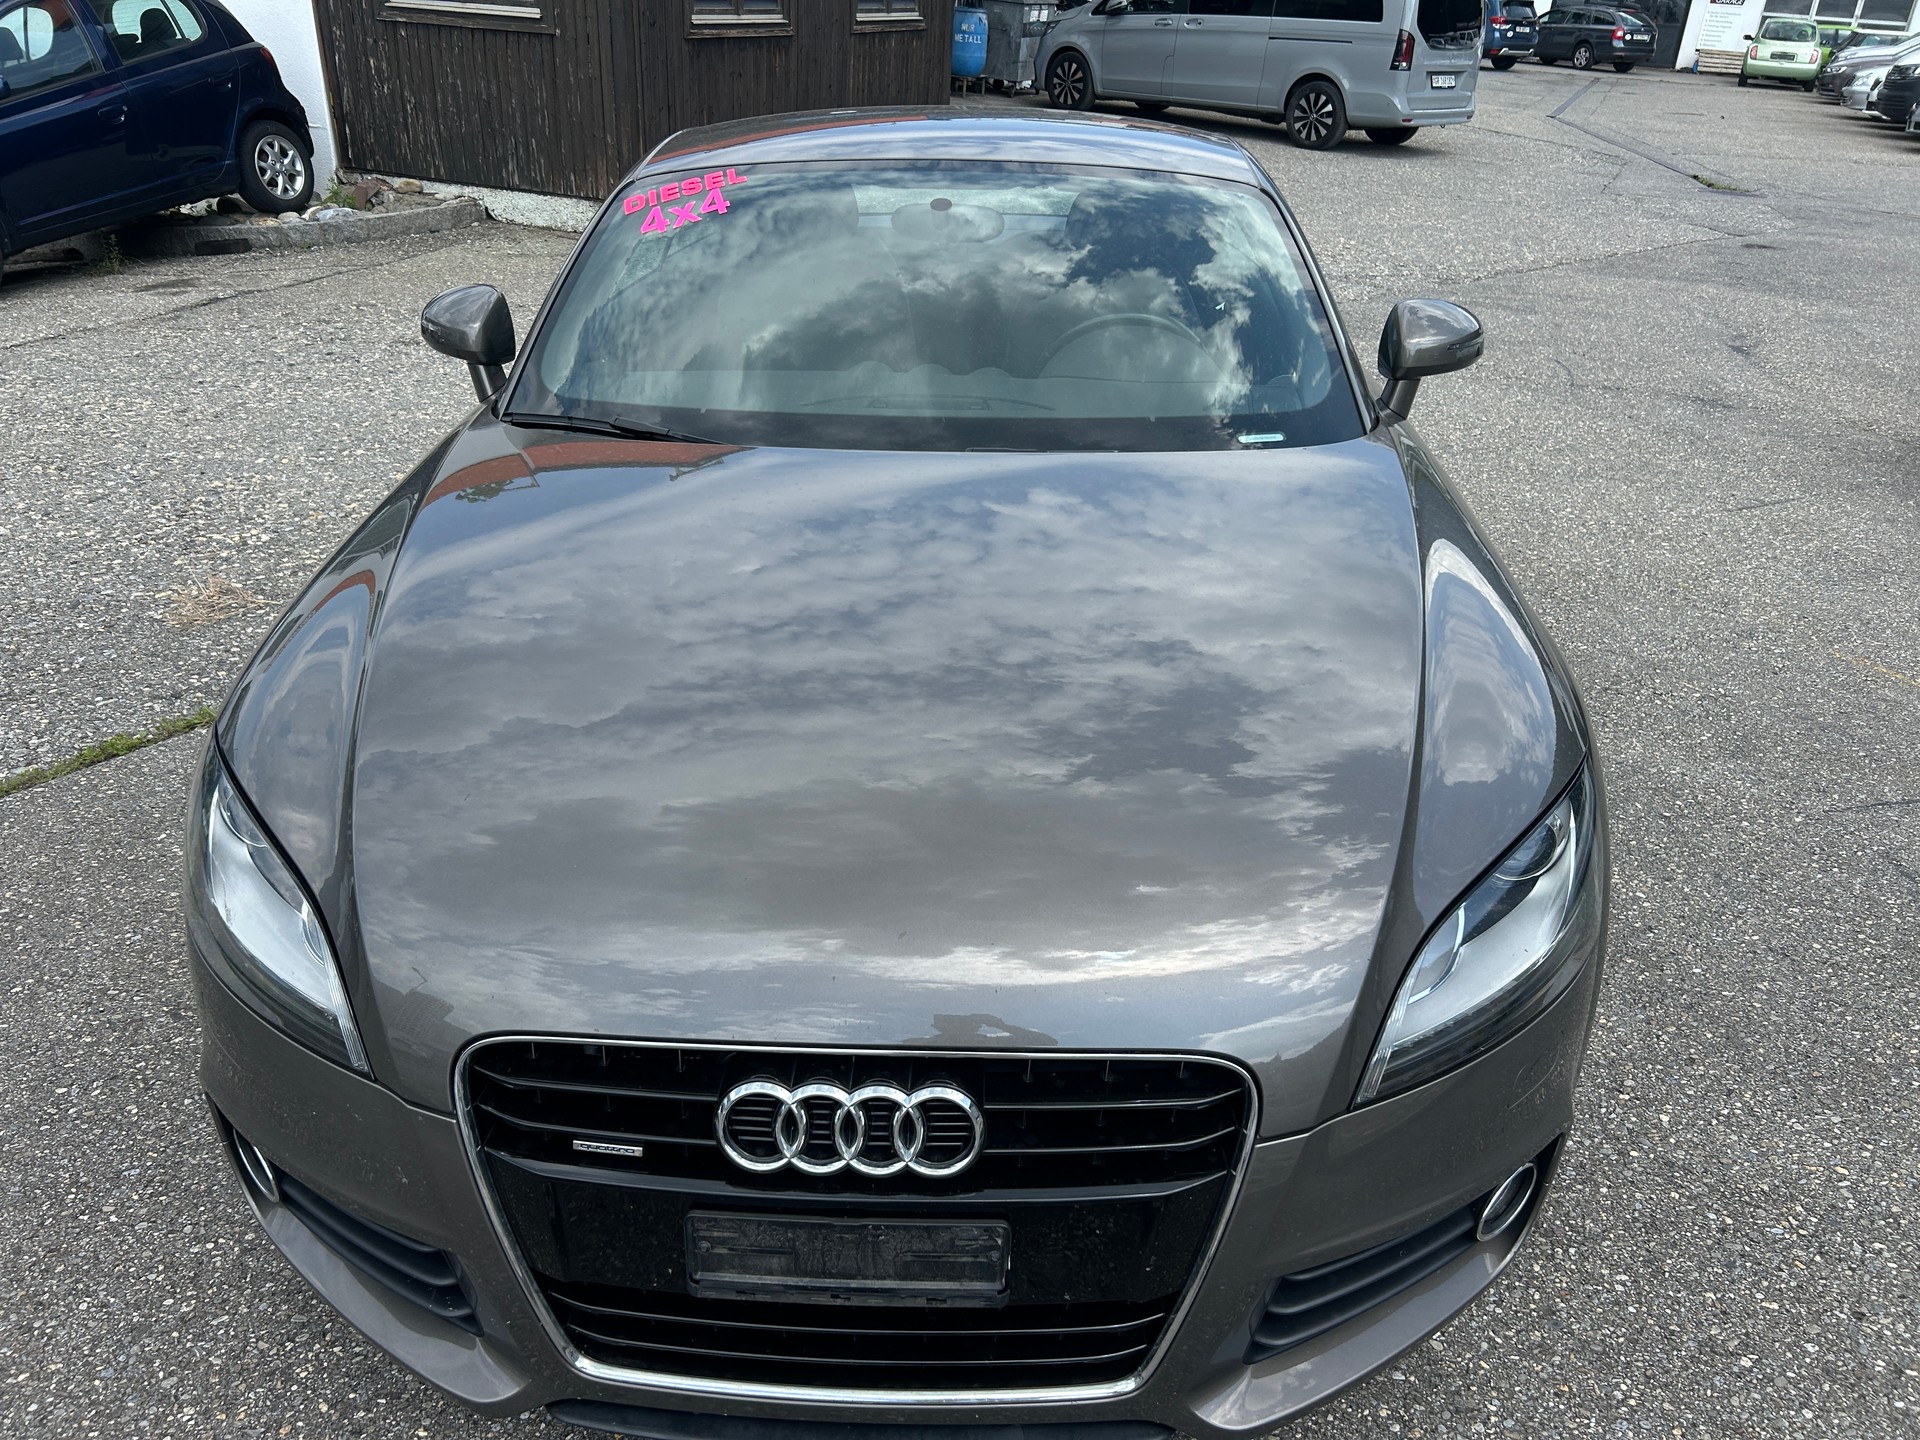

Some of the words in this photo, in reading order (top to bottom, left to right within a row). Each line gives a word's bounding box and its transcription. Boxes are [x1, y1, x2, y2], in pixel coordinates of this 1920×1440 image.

[961, 23, 975, 32] NUR
[954, 33, 982, 43] METALL
[623, 168, 748, 216] DIESEL
[580, 1143, 635, 1154] quattro
